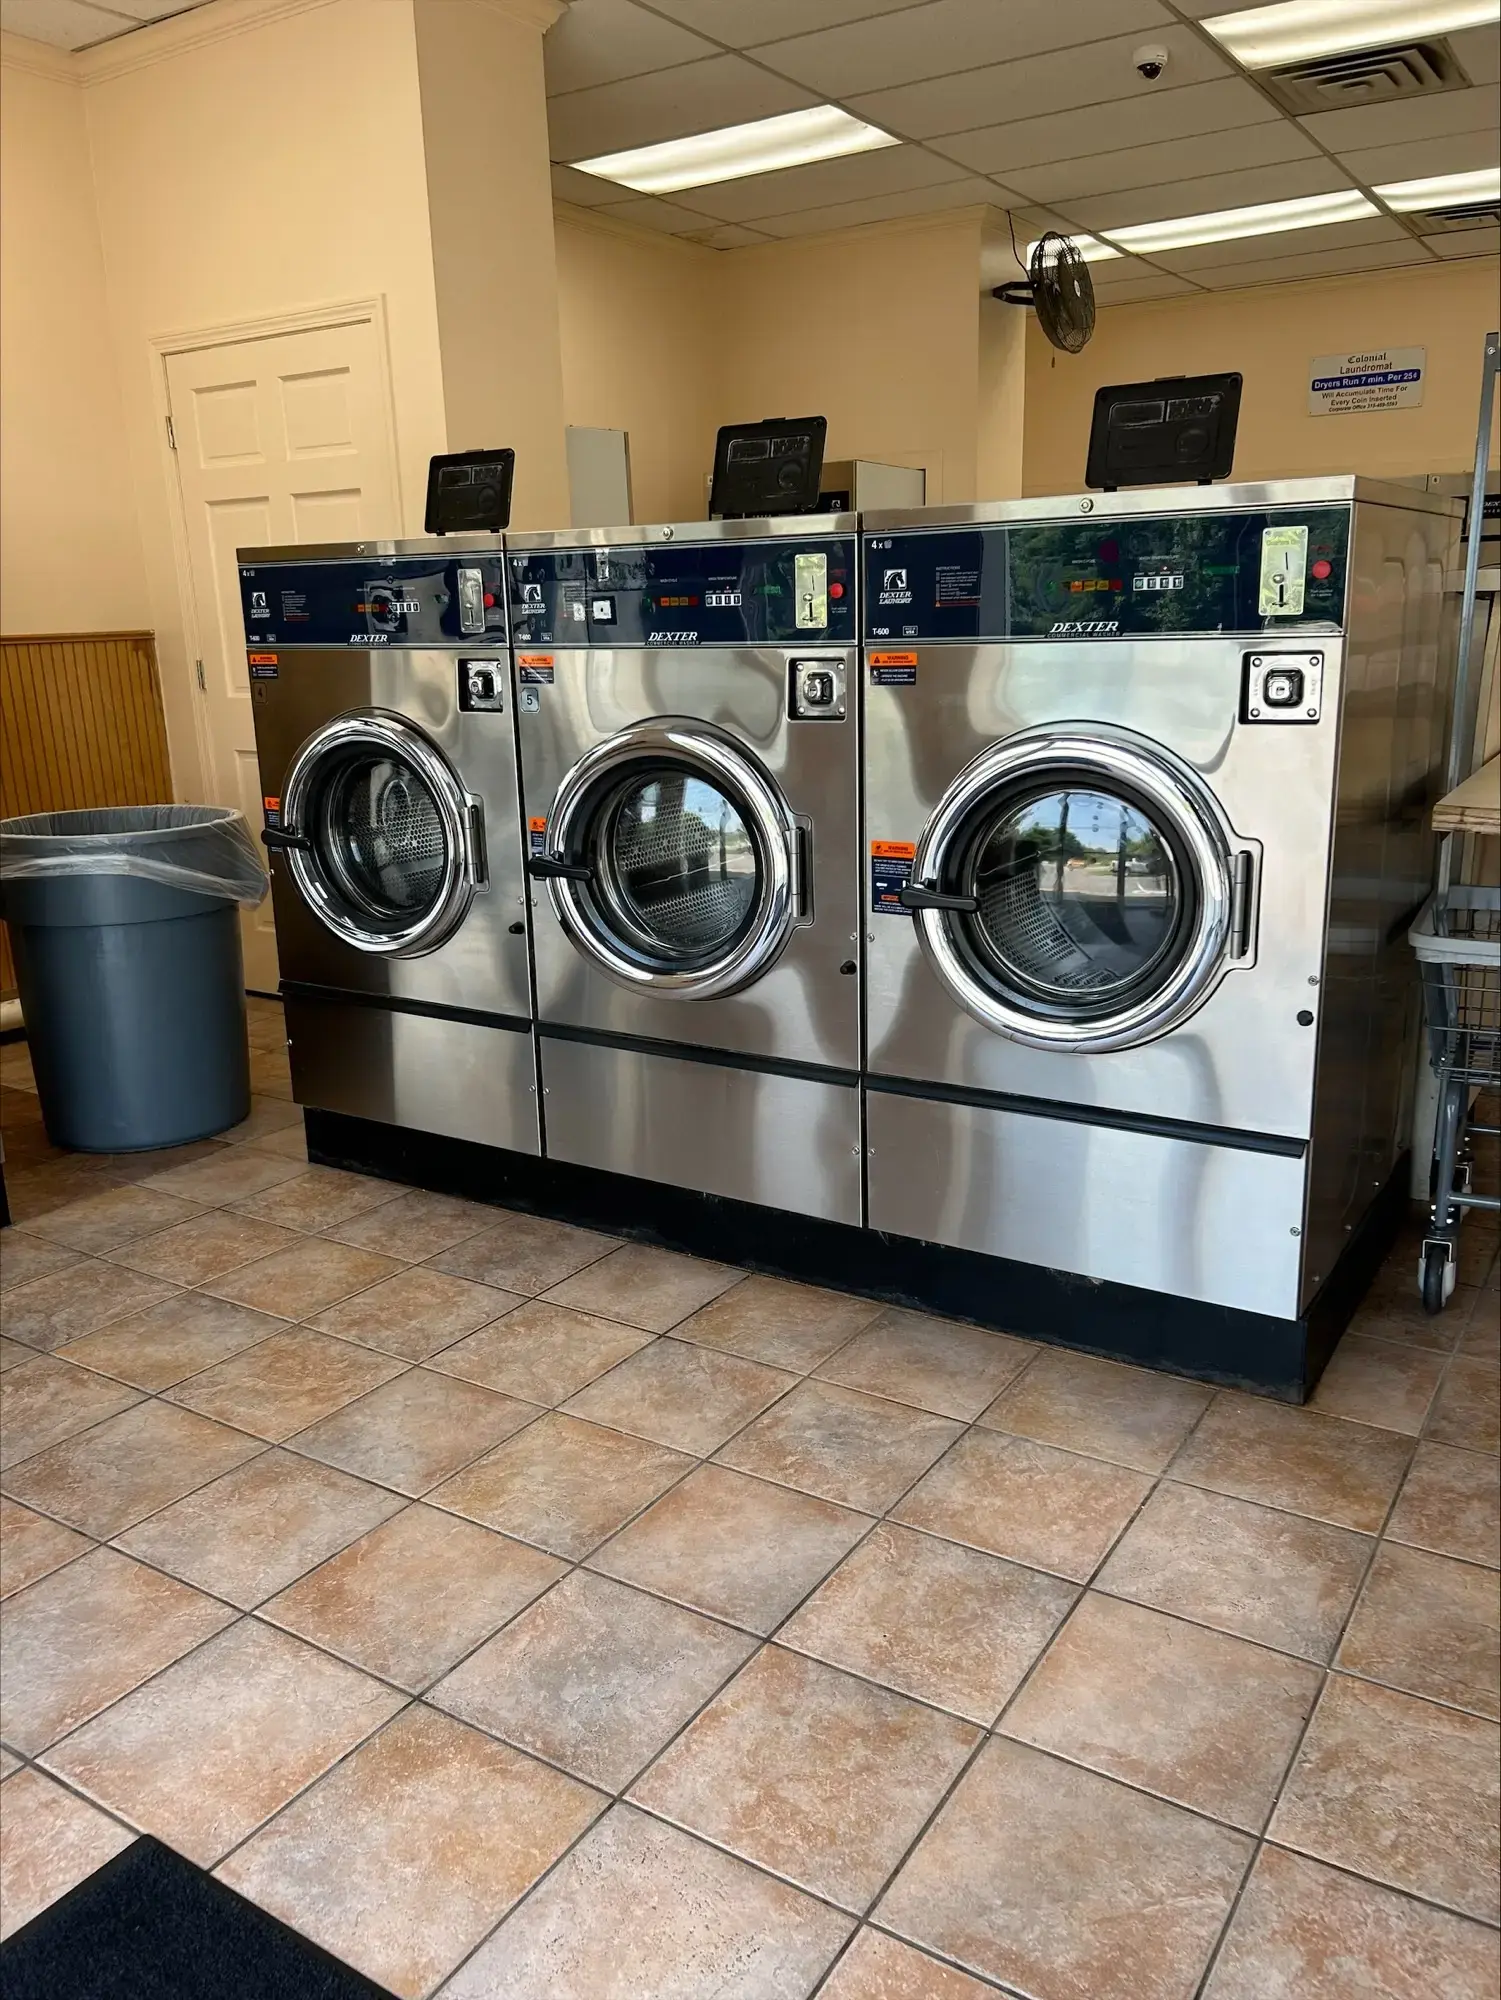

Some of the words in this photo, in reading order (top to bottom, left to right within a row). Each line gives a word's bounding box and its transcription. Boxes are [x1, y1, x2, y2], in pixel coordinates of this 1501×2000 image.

[1348, 352, 1386, 364] Colonial
[1340, 362, 1392, 374] Laundromat
[1314, 379, 1340, 390] Dryers
[1342, 378, 1359, 386] Run
[1368, 374, 1385, 383] min.
[1388, 373, 1402, 381] Per
[1336, 388, 1376, 398] Accumulate
[1368, 394, 1397, 403] Inserted
[871, 540, 877, 549] 4
[1050, 621, 1119, 633] DEXTER
[648, 632, 698, 641] DEXTER
[526, 694, 533, 705] 5
